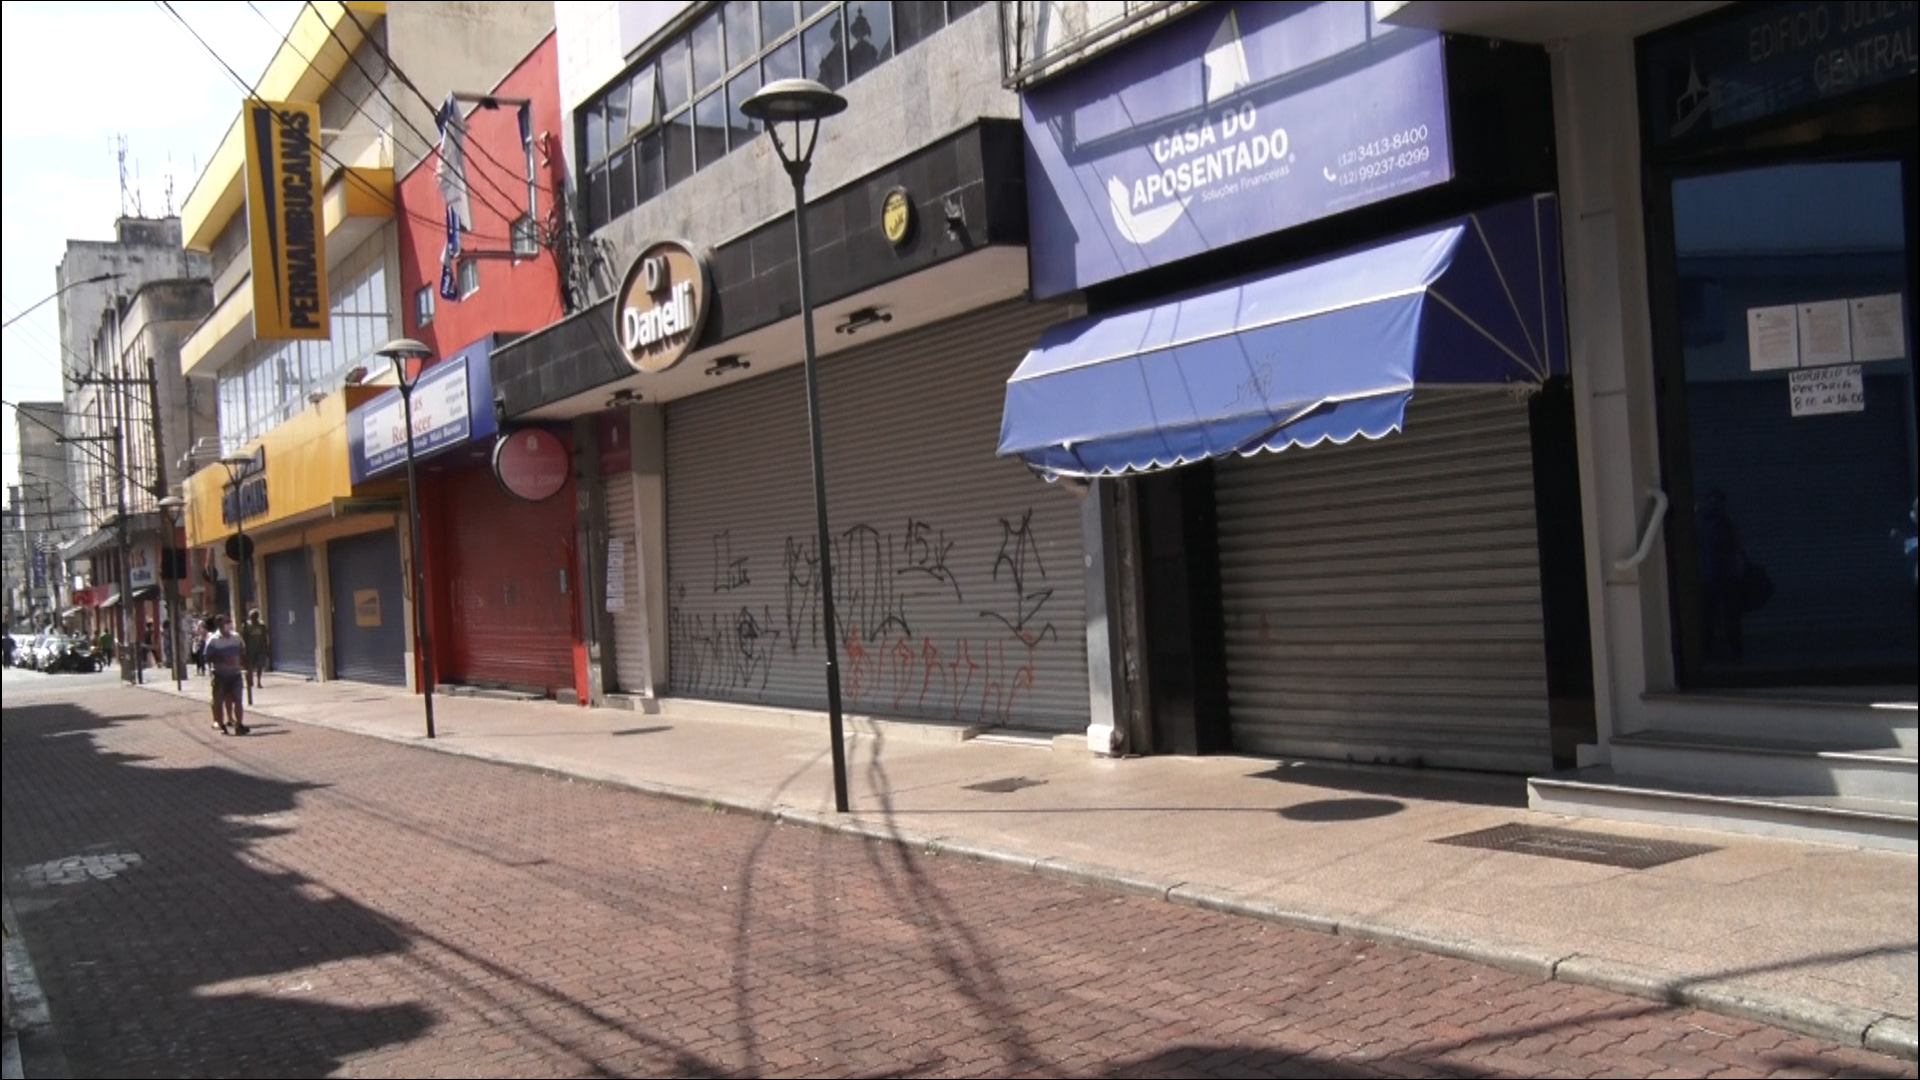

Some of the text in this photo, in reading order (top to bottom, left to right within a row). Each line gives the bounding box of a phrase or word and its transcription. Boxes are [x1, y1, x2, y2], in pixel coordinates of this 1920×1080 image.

[1813, 25, 1918, 92] CENTRAL
[1153, 100, 1258, 164] CASA DO
[1357, 123, 1429, 162] 3413-8400
[1358, 145, 1431, 182] 99237-6299
[1131, 128, 1289, 210] APOSENTADO
[1201, 165, 1291, 202] Soluções Financeiras
[278, 109, 321, 330] PERNAMBUCANAS
[622, 280, 696, 350] Danelli
